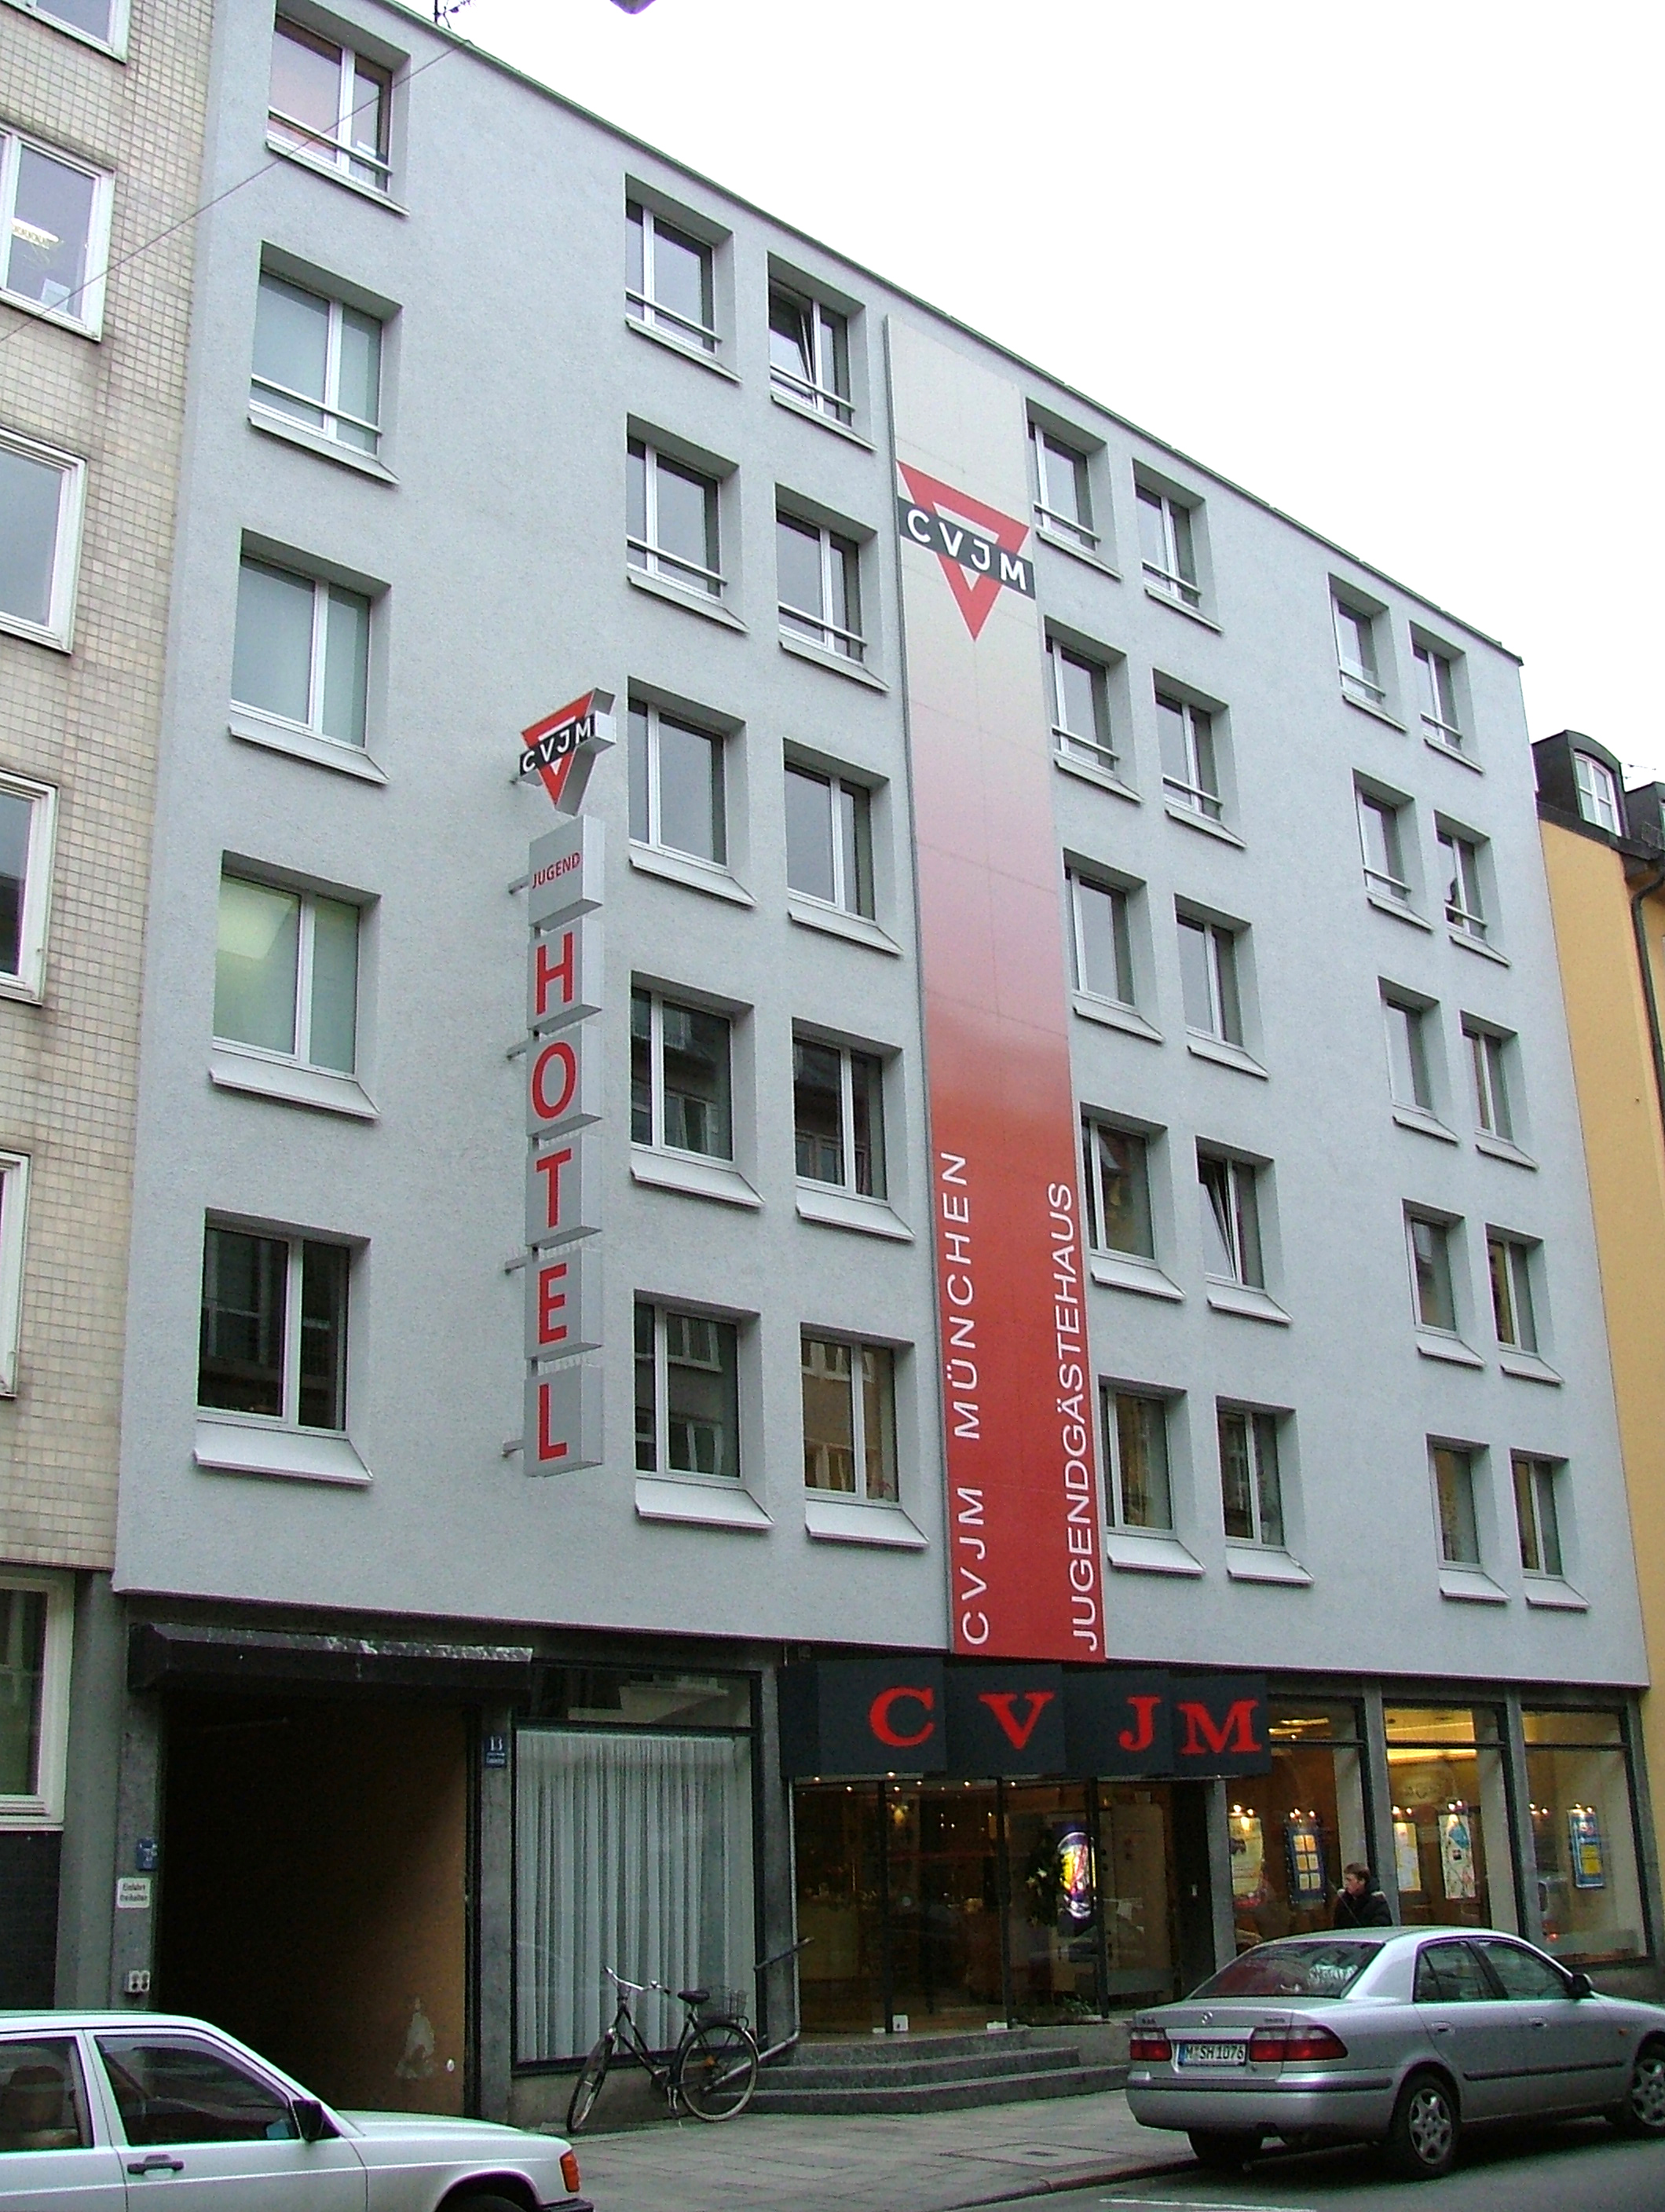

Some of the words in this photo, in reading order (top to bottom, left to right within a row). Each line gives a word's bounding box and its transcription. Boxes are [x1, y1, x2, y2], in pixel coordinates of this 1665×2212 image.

[907, 508, 1026, 591] CVJM
[522, 718, 591, 773] CVJM
[532, 852, 581, 889] JUGEND
[531, 932, 576, 1463] HOTEL
[940, 1151, 981, 1441] MÜNCHEN
[1047, 1181, 1098, 1652] JUGENDGÄSTEHAUS
[957, 1486, 990, 1646] CVJM
[869, 1686, 1261, 1755] CVJM
